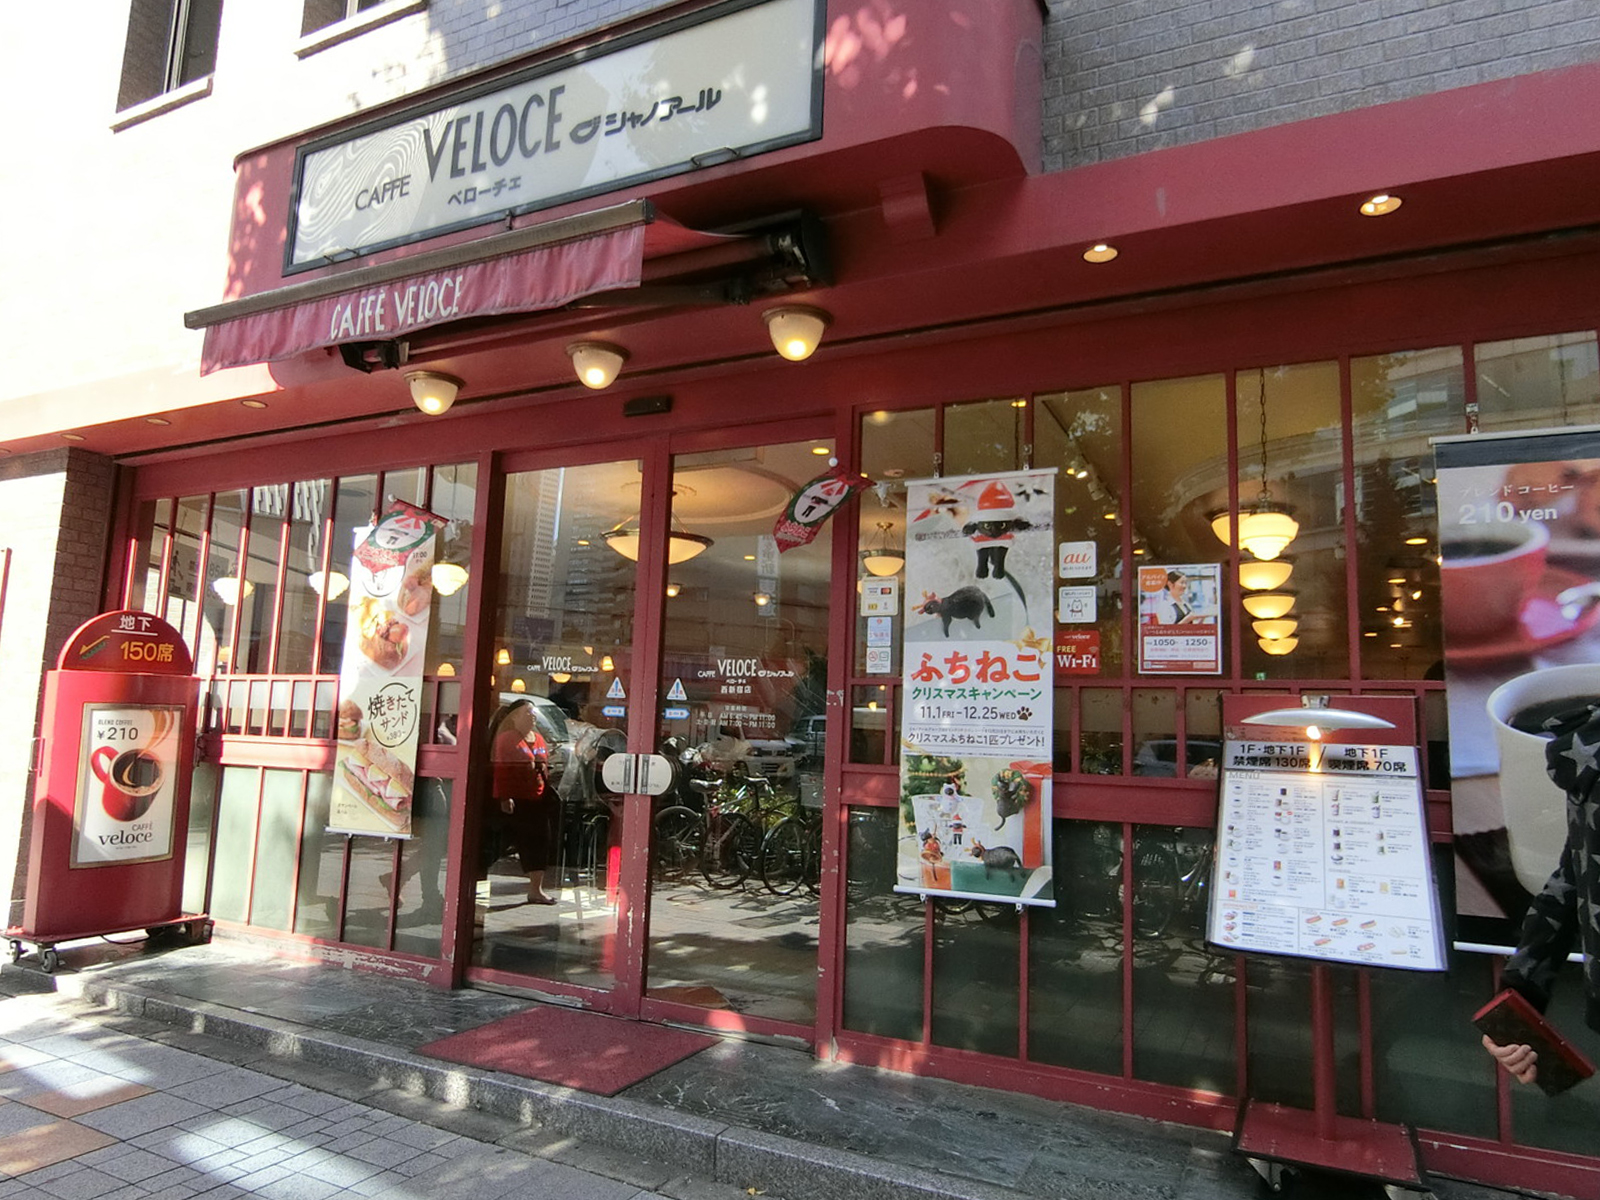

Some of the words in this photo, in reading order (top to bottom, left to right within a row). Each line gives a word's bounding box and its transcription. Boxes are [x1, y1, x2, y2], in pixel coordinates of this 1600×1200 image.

[604, 87, 722, 136] シャノアール
[355, 174, 412, 211] CAFFE
[423, 84, 566, 183] VELOCE
[447, 176, 522, 205] ベローチェ
[331, 289, 386, 340] CAFFÈ
[394, 275, 463, 327] VELOCE
[1518, 484, 1575, 495] コーヒー
[1459, 501, 1515, 525] 210
[1519, 507, 1558, 524] yen
[1063, 553, 1092, 564] au
[119, 614, 153, 631] 地下
[1056, 645, 1077, 653] FREE
[1153, 638, 1176, 647] 1050
[1185, 638, 1208, 647] 1250
[120, 641, 175, 662] 150席
[542, 656, 571, 671] VELOCE
[717, 659, 757, 677] VELOCE
[911, 650, 1041, 685] ふちねこ
[1056, 654, 1097, 668] Wi-Fi
[912, 686, 1042, 701] クリスマスキャンペーン
[367, 688, 415, 721] 焼きたて
[380, 710, 409, 733] サンド
[1344, 747, 1389, 759] 地下1F
[1233, 755, 1272, 767] 禁煙席
[1275, 757, 1312, 769] 130席
[1374, 761, 1407, 772] 70席
[98, 830, 153, 846] veloce
